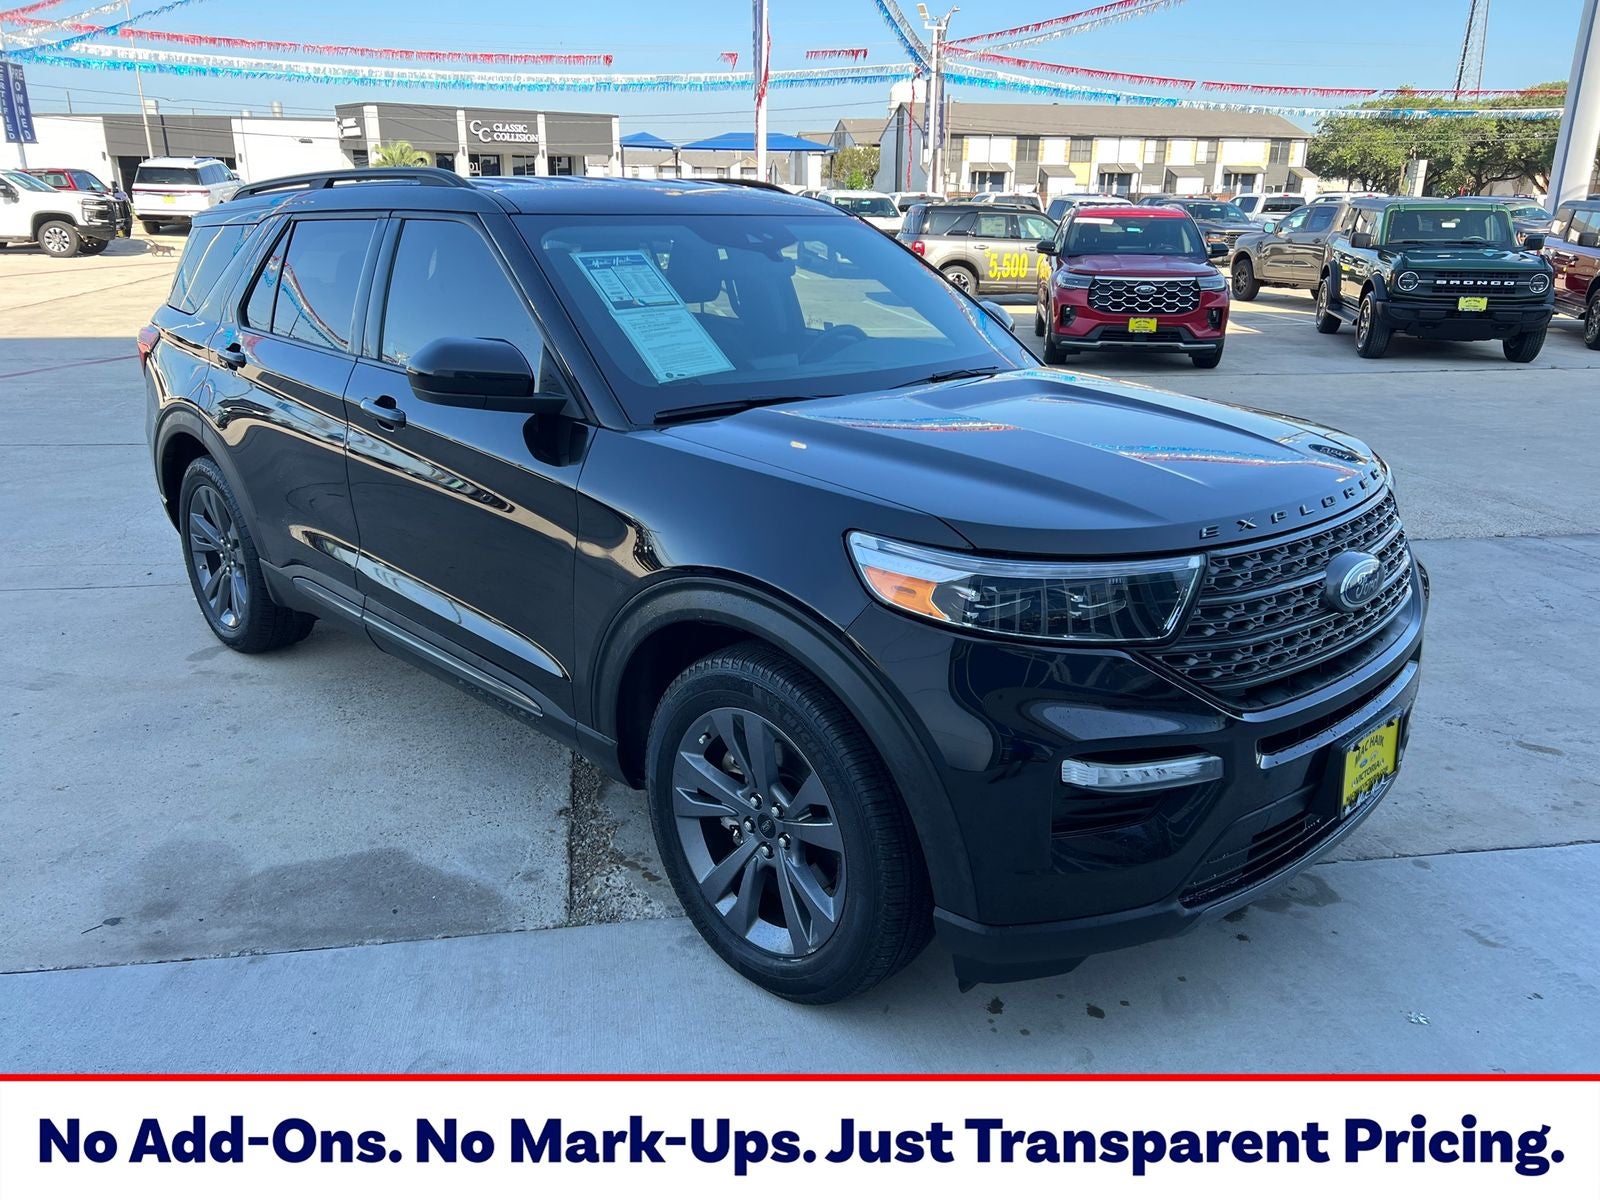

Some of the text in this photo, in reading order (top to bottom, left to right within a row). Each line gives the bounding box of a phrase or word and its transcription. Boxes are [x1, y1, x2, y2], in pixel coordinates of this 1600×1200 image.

[15, 82, 32, 140] OWNED
[493, 123, 528, 133] CLASSIC
[493, 132, 539, 143] COLLISION
[1199, 467, 1381, 540] EXPLORER
[1355, 571, 1380, 600] Ford
